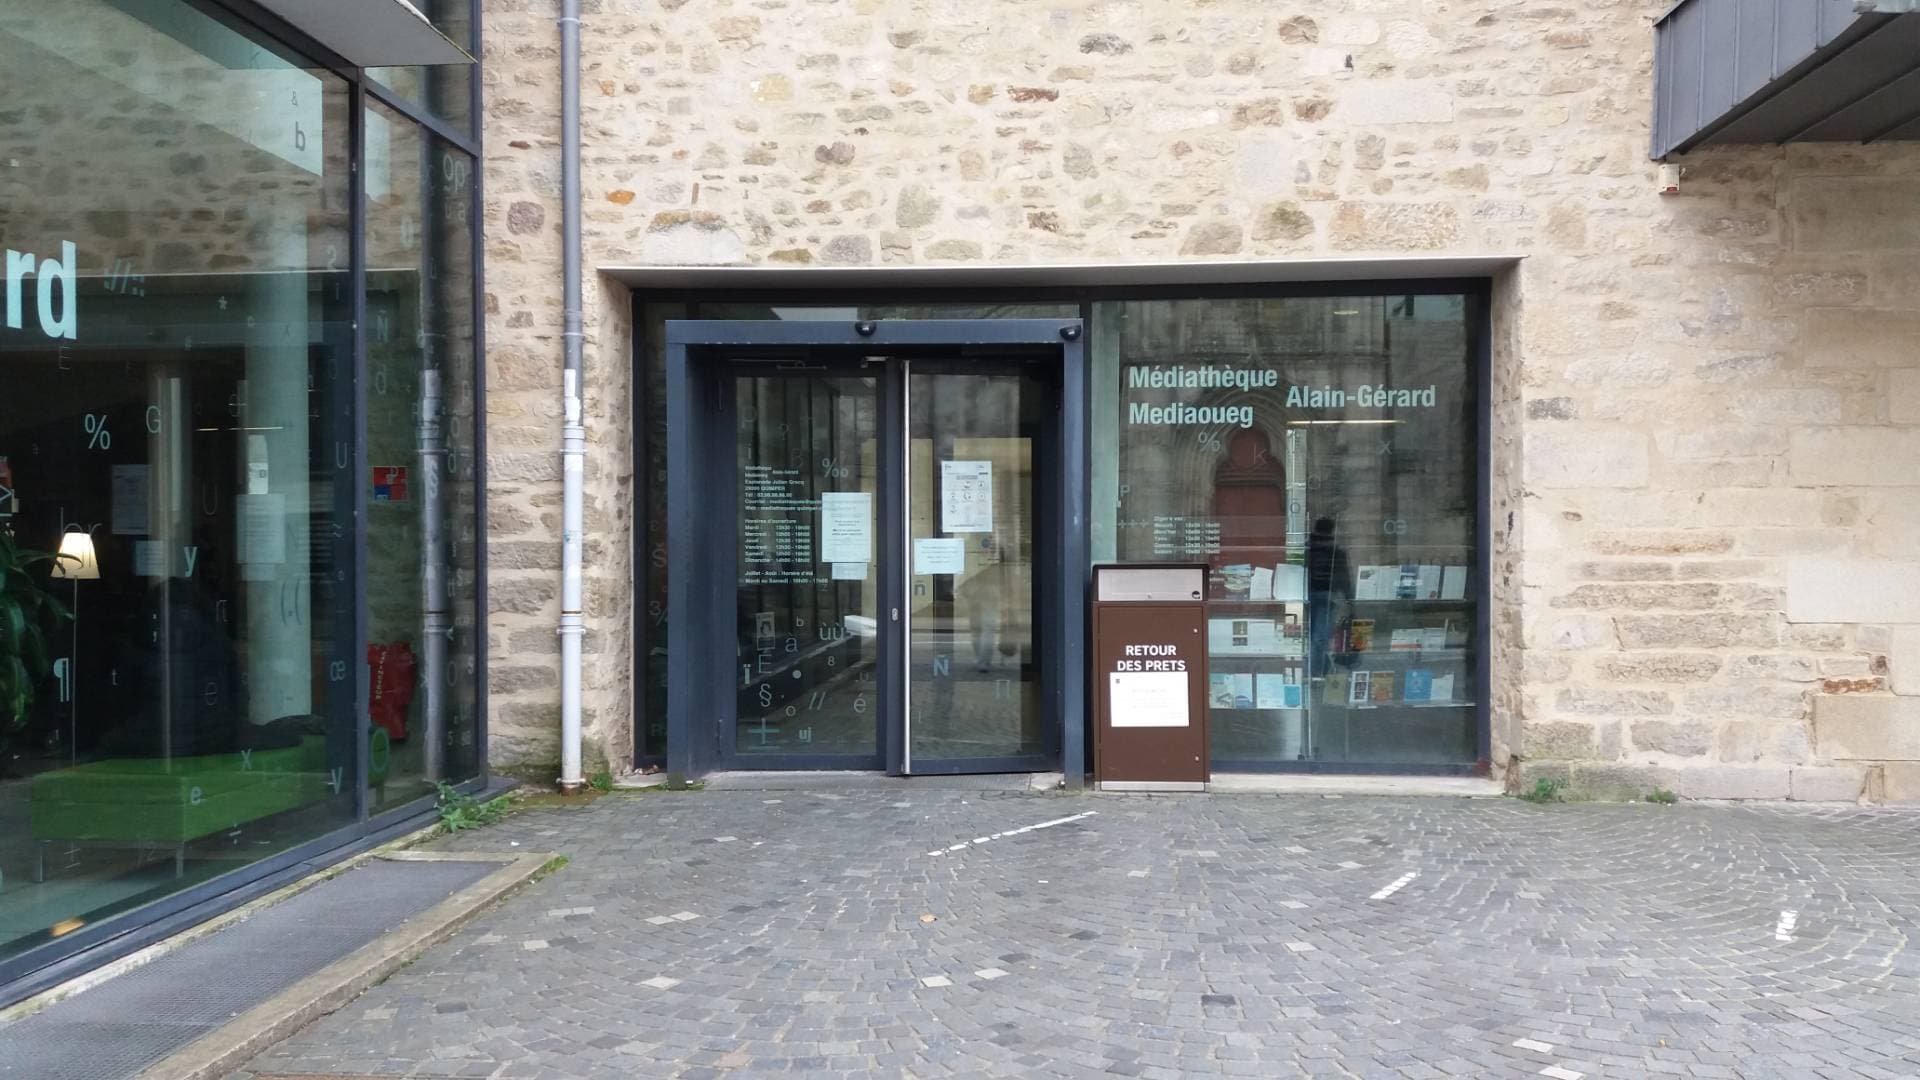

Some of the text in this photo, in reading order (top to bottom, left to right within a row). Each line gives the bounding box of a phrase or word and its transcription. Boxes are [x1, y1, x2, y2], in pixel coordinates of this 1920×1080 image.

[6, 240, 77, 340] rd
[1128, 364, 1278, 391] Médiathèque
[1286, 384, 1437, 409] Alain-Gérard
[1128, 402, 1254, 428] Mediaoueg
[84, 413, 112, 451] %
[1125, 645, 1177, 656] RETOUR
[1116, 659, 1186, 672] DES PRETS
